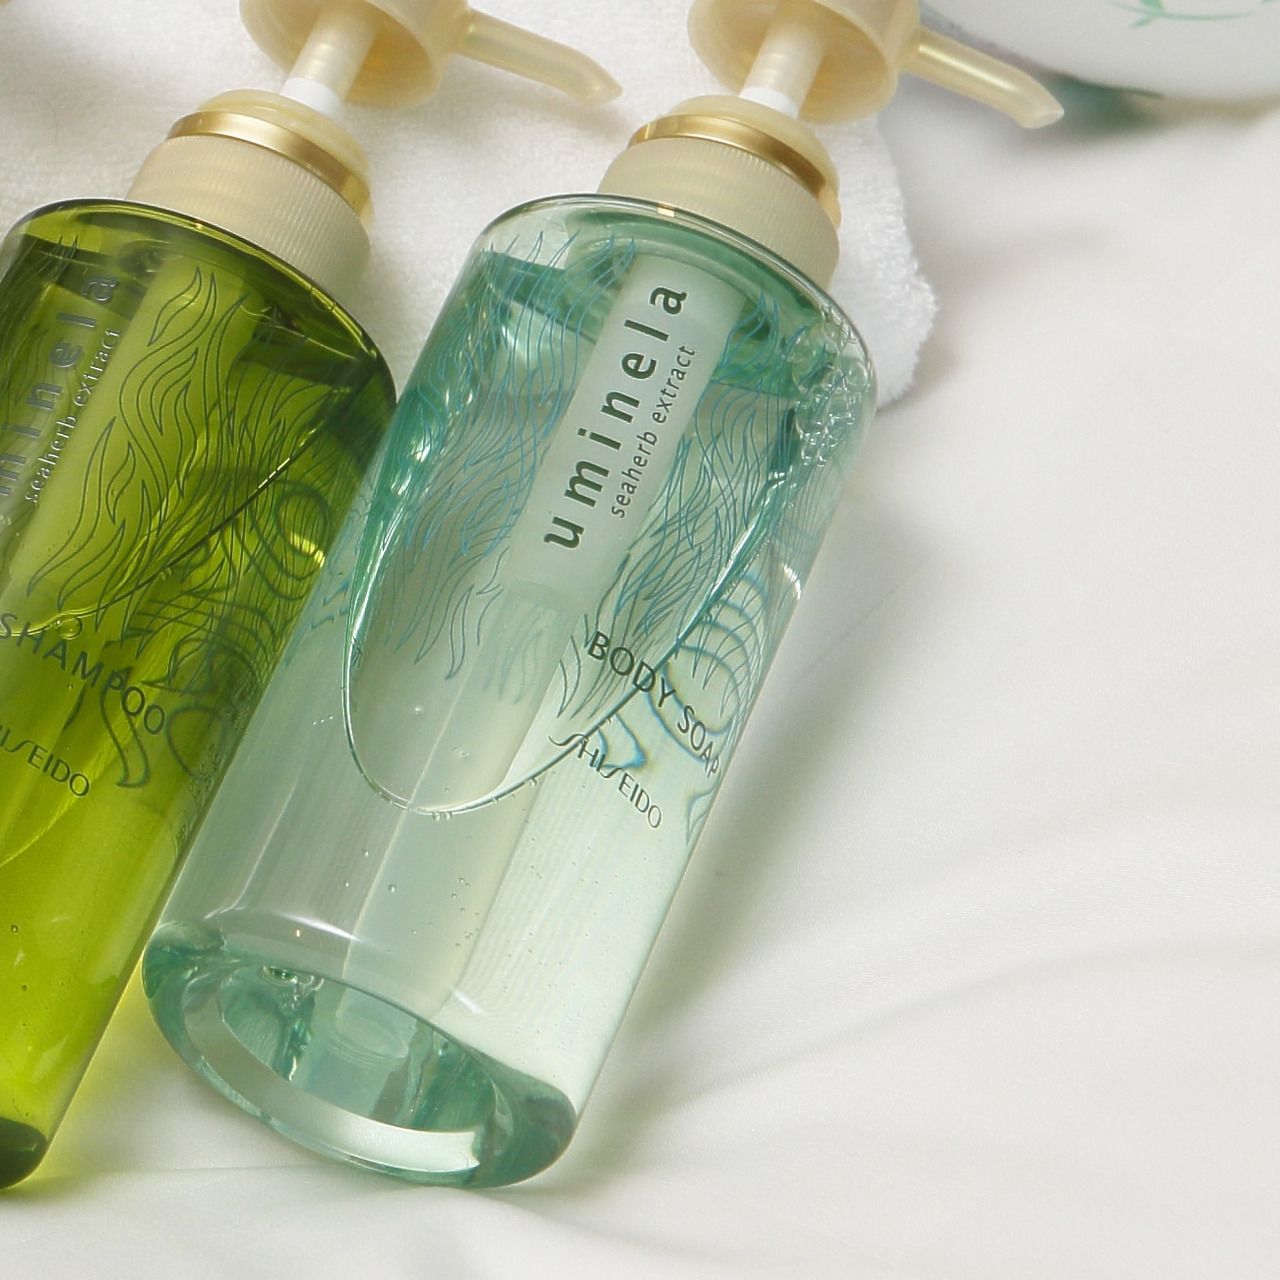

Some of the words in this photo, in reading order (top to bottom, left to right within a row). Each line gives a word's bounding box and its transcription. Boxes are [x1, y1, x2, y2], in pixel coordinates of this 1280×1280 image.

[543, 284, 688, 551] uminela
[610, 429, 659, 519] seaherb
[650, 344, 697, 425] extract
[548, 733, 663, 829] SHISEIDO
[587, 631, 676, 708] BODY
[676, 705, 721, 779] SOAP
